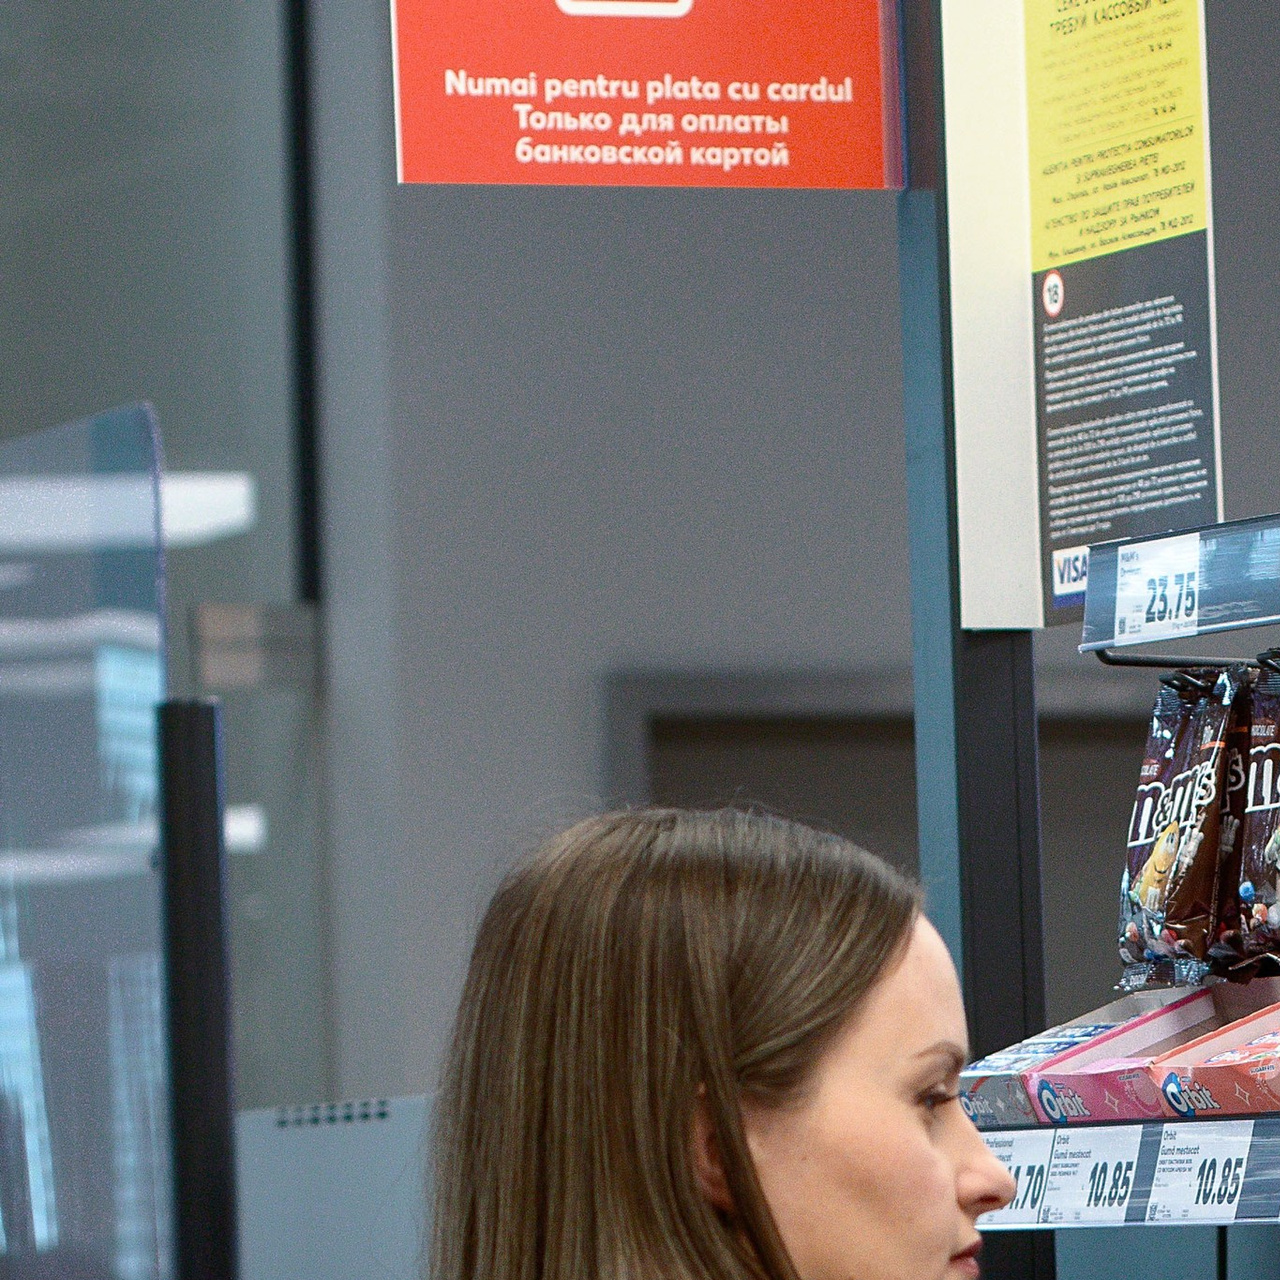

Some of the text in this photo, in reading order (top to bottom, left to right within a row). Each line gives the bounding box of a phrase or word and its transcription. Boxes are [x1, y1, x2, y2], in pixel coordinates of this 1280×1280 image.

[445, 69, 853, 104] Numai pentru plata cu cardul
[513, 103, 789, 137] Только для оплаты
[514, 137, 789, 172] банковской картой
[1047, 283, 1060, 304] 18
[1057, 553, 1088, 585] VISA
[1145, 571, 1196, 624] 23.75
[1041, 1089, 1091, 1118] Orbit
[1166, 1082, 1221, 1117] Orbit
[1056, 1135, 1070, 1145] Orbit
[1163, 1130, 1177, 1141] Orbit
[1176, 1144, 1200, 1155] mestecat
[1069, 1149, 1092, 1159] mestecat
[1086, 1161, 1134, 1208] 10.85
[1194, 1157, 1244, 1206] 10.85
